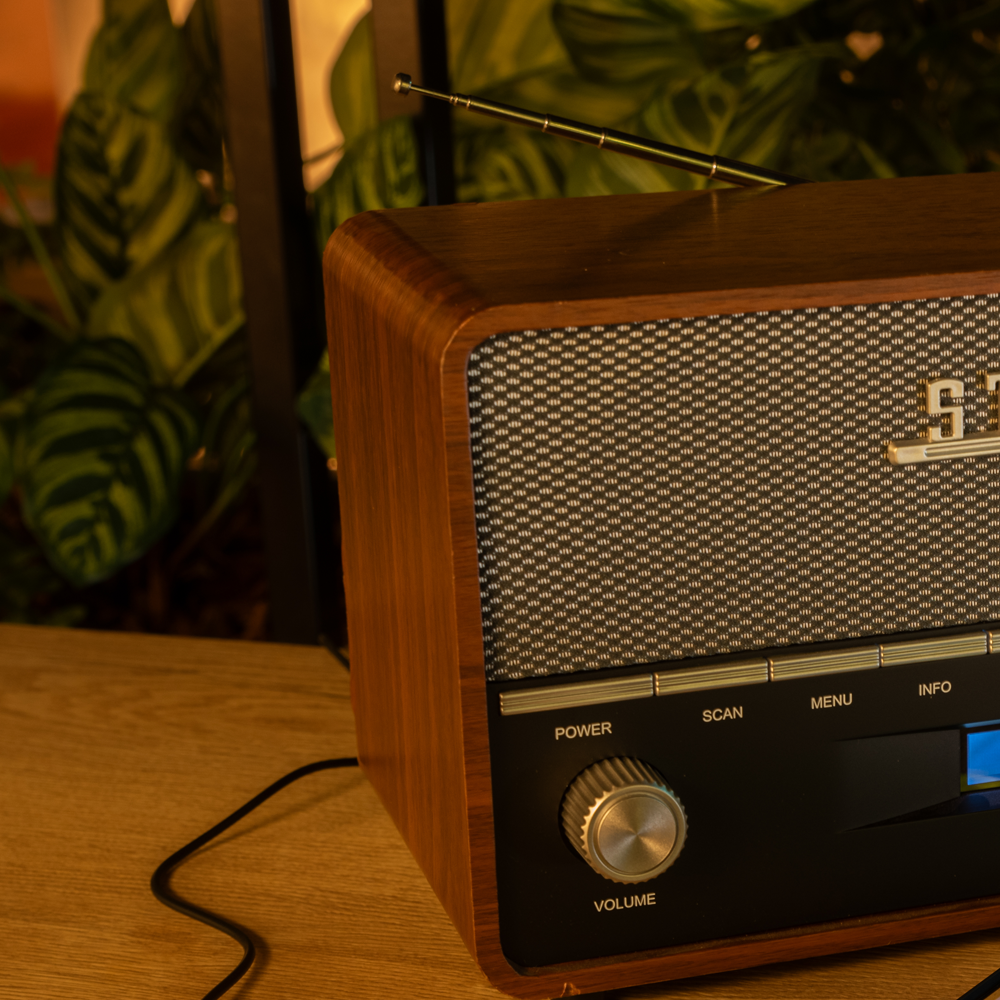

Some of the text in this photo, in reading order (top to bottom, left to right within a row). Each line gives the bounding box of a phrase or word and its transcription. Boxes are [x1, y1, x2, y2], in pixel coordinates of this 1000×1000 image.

[918, 681, 952, 697] INFO
[810, 693, 853, 710] MENU
[702, 706, 744, 723] SCAN
[554, 721, 613, 741] POWER
[594, 892, 656, 913] VOLUME
